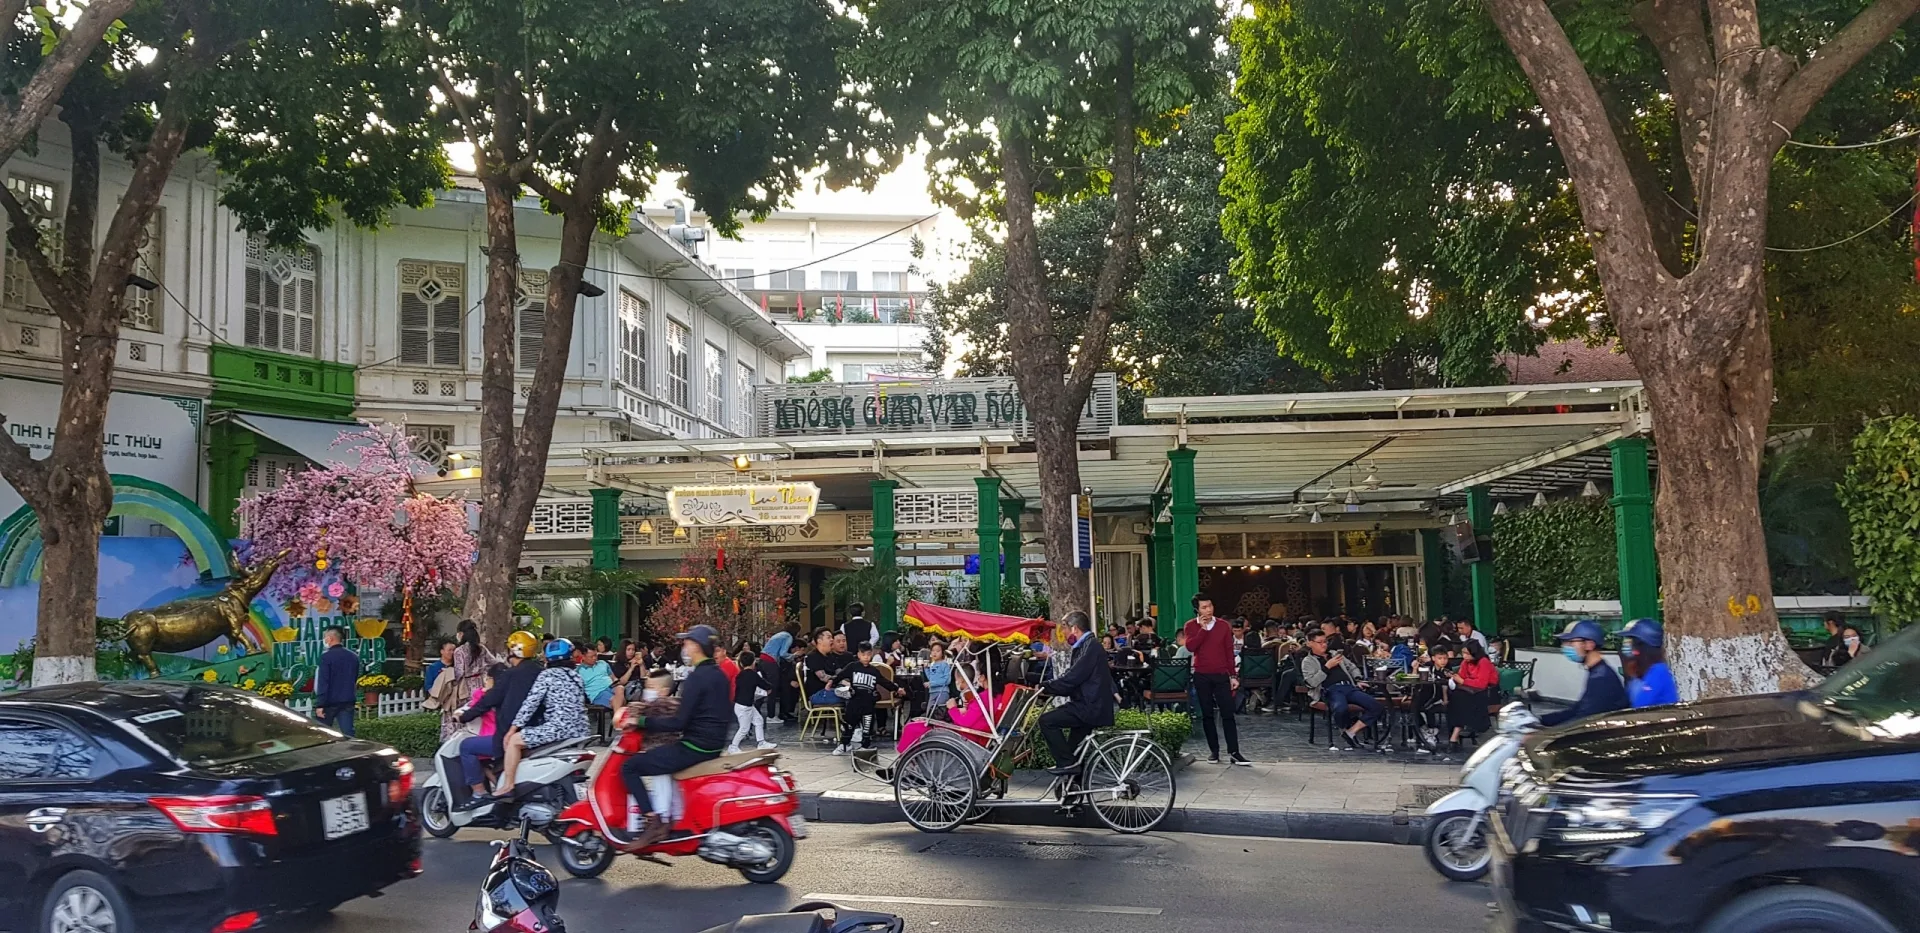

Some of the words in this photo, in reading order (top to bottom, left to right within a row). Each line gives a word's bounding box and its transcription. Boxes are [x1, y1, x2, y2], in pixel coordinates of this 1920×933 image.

[1728, 594, 1762, 617] 60
[272, 640, 324, 669] NEW
[852, 671, 877, 688] WHITE
